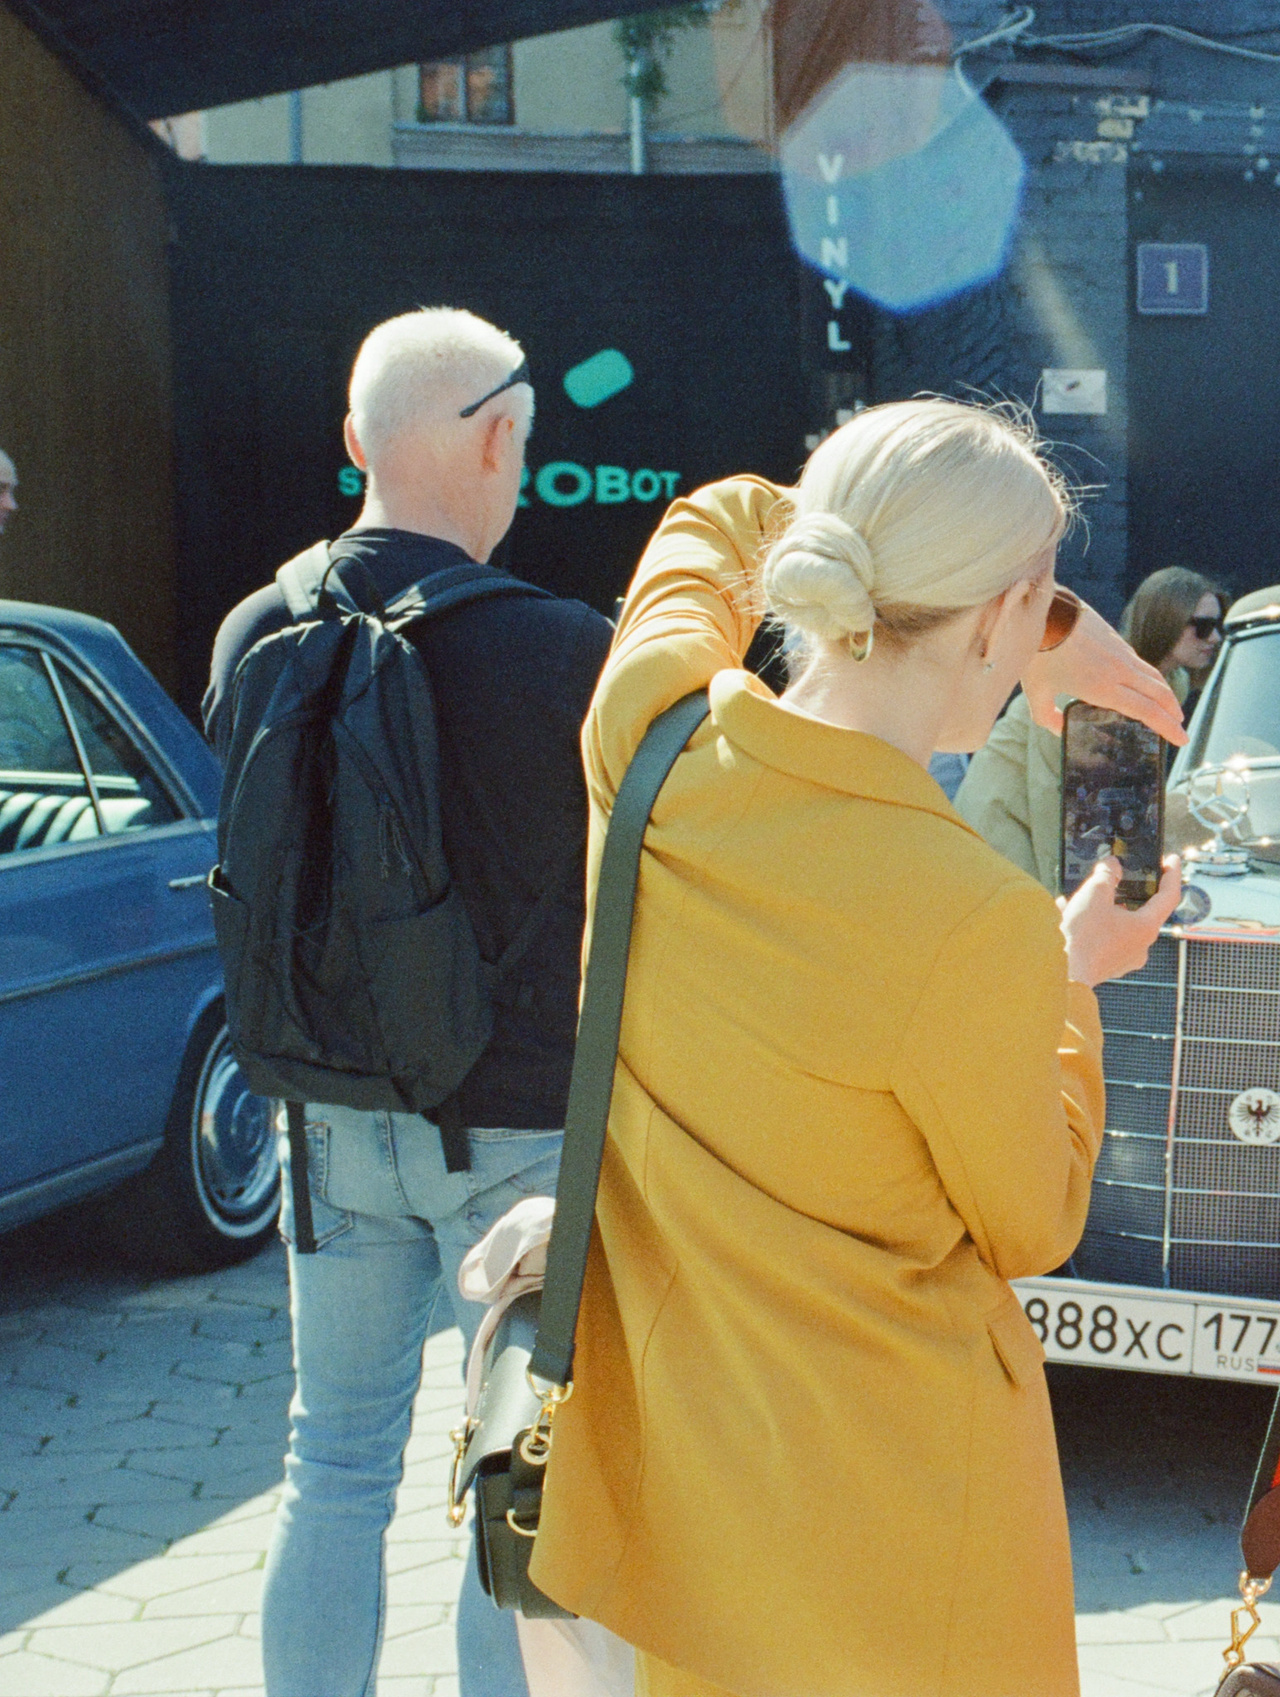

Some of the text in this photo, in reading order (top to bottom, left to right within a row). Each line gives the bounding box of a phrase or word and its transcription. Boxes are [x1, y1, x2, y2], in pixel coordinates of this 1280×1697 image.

[817, 154, 851, 350] VINYL
[1164, 261, 1178, 295] 1
[1203, 1313, 1278, 1355] 177
[1216, 1355, 1255, 1372] RUS
